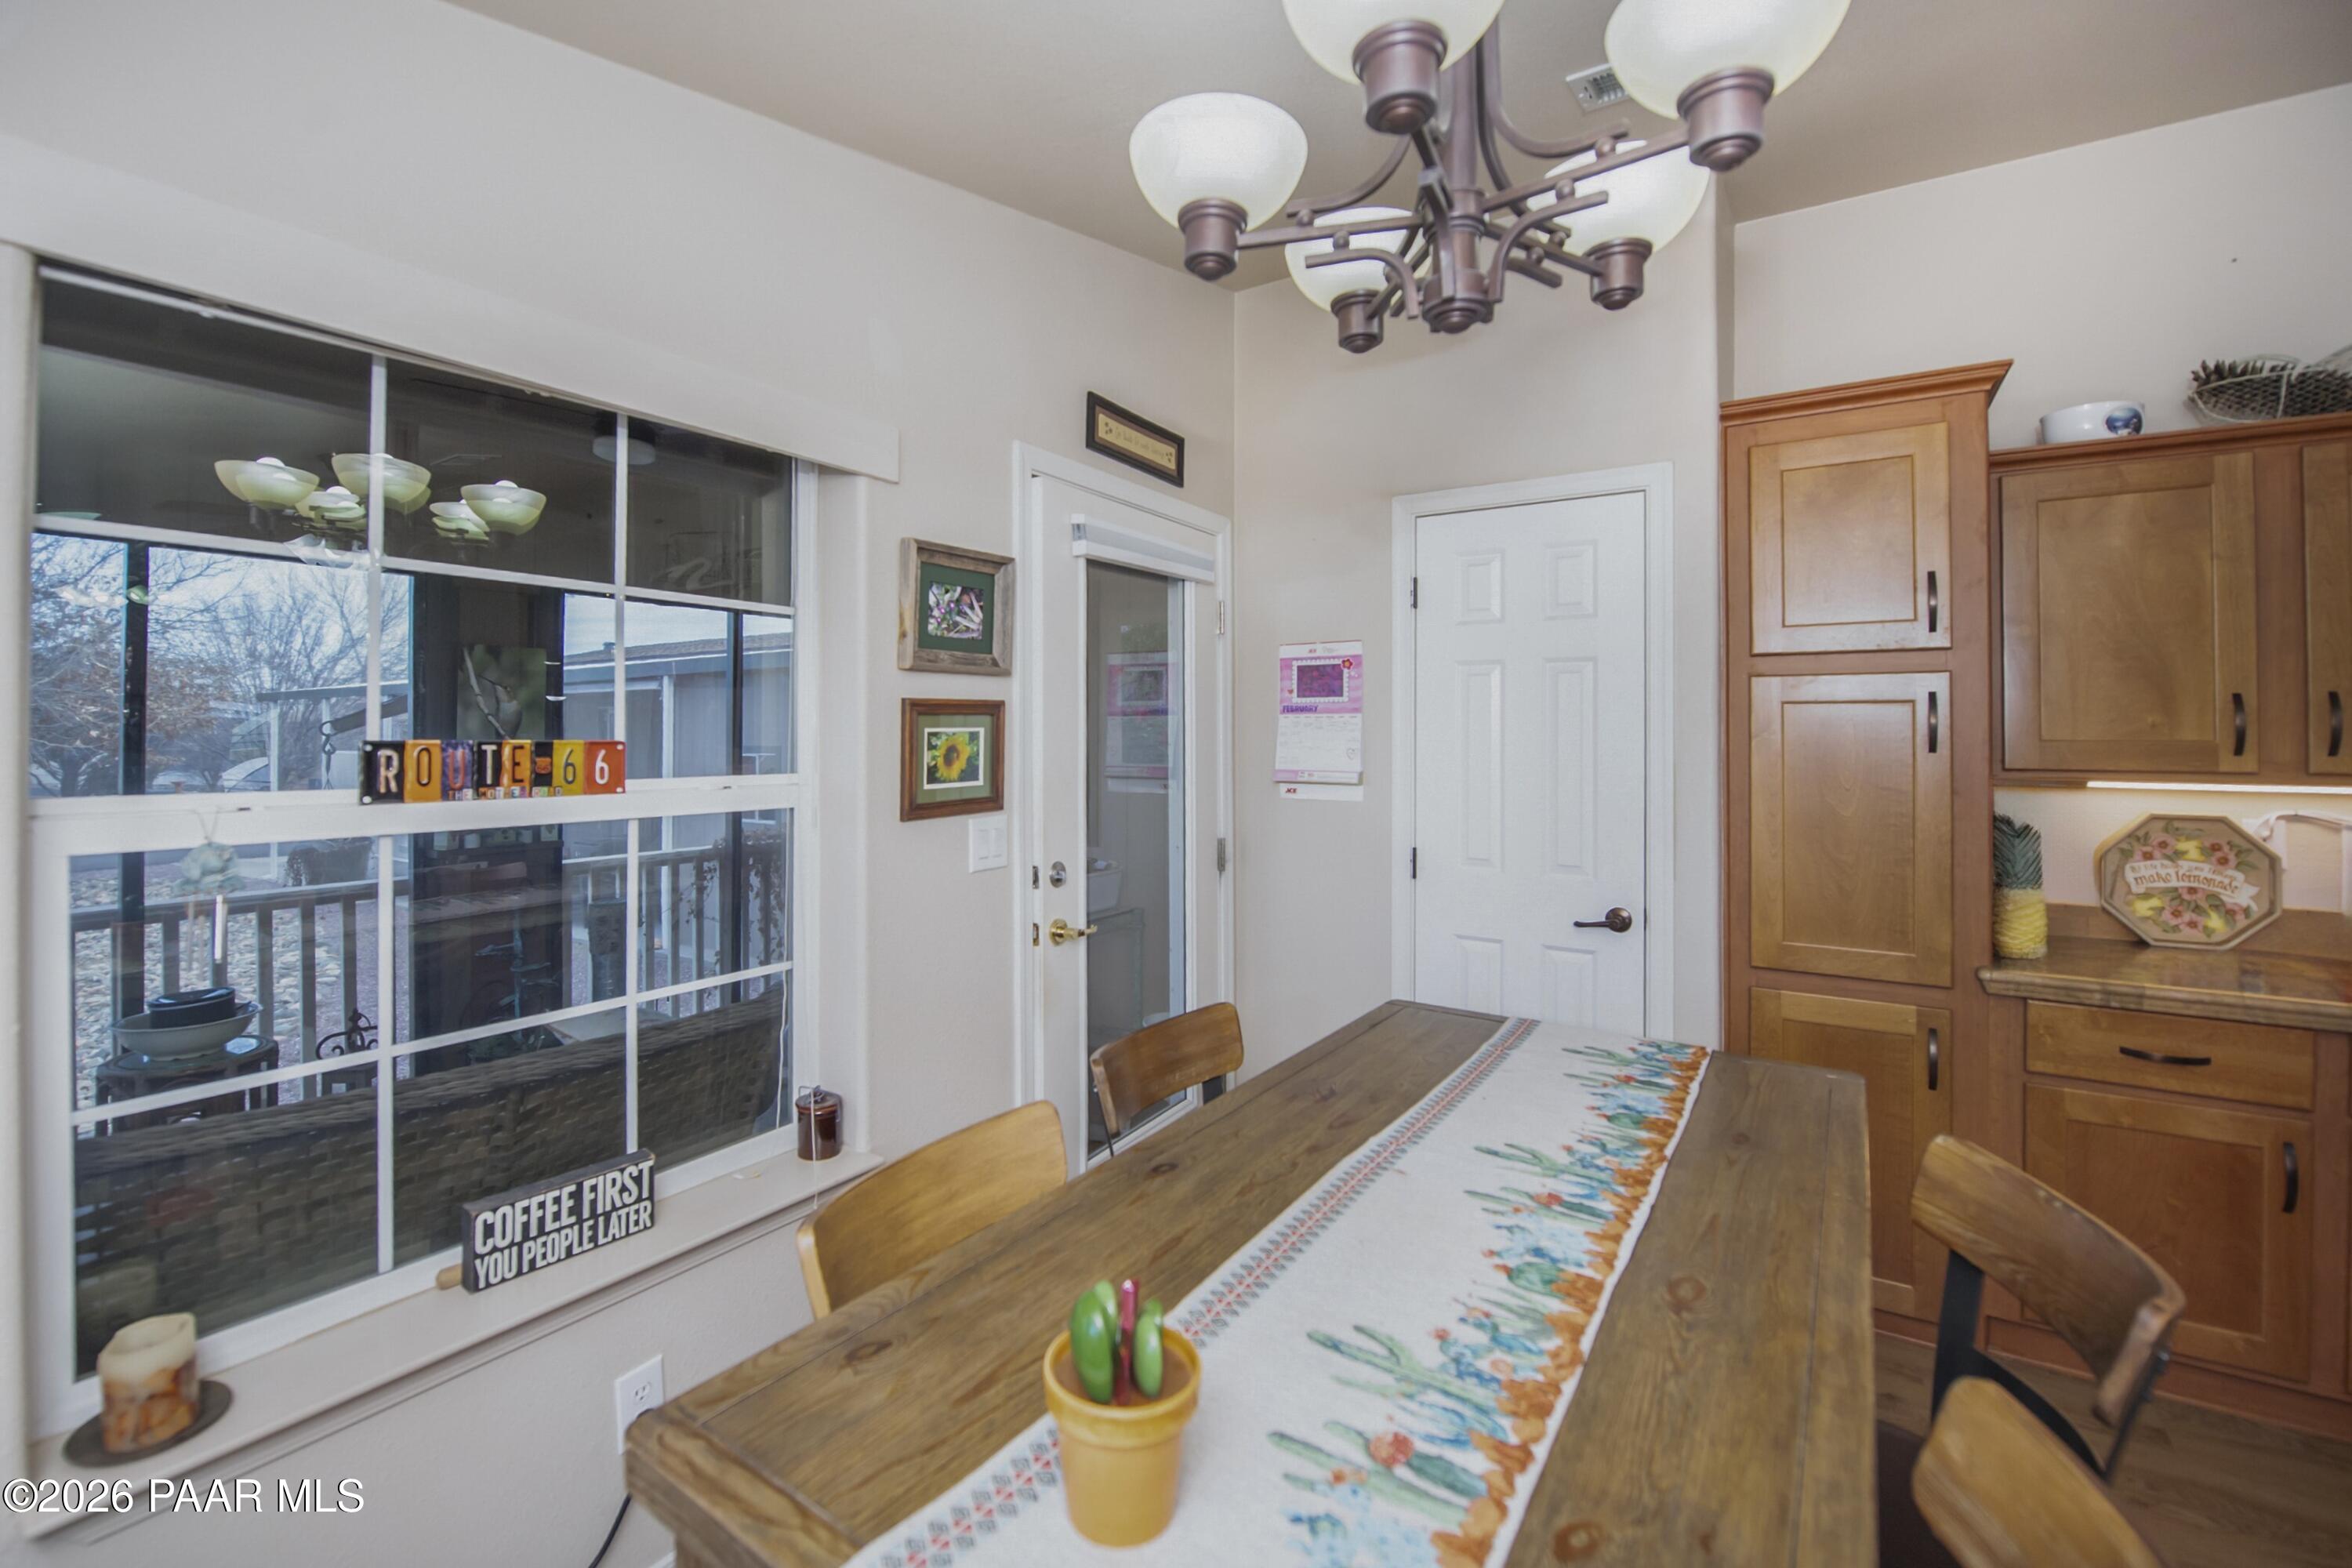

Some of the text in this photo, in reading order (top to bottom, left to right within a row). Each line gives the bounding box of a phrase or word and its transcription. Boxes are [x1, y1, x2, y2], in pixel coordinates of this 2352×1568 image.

[377, 744, 610, 793] ROUTE 66
[448, 789, 472, 800] THE
[474, 1160, 655, 1254] COFFEE FIRST
[474, 1200, 652, 1290] YOU PEOPLE LATER
